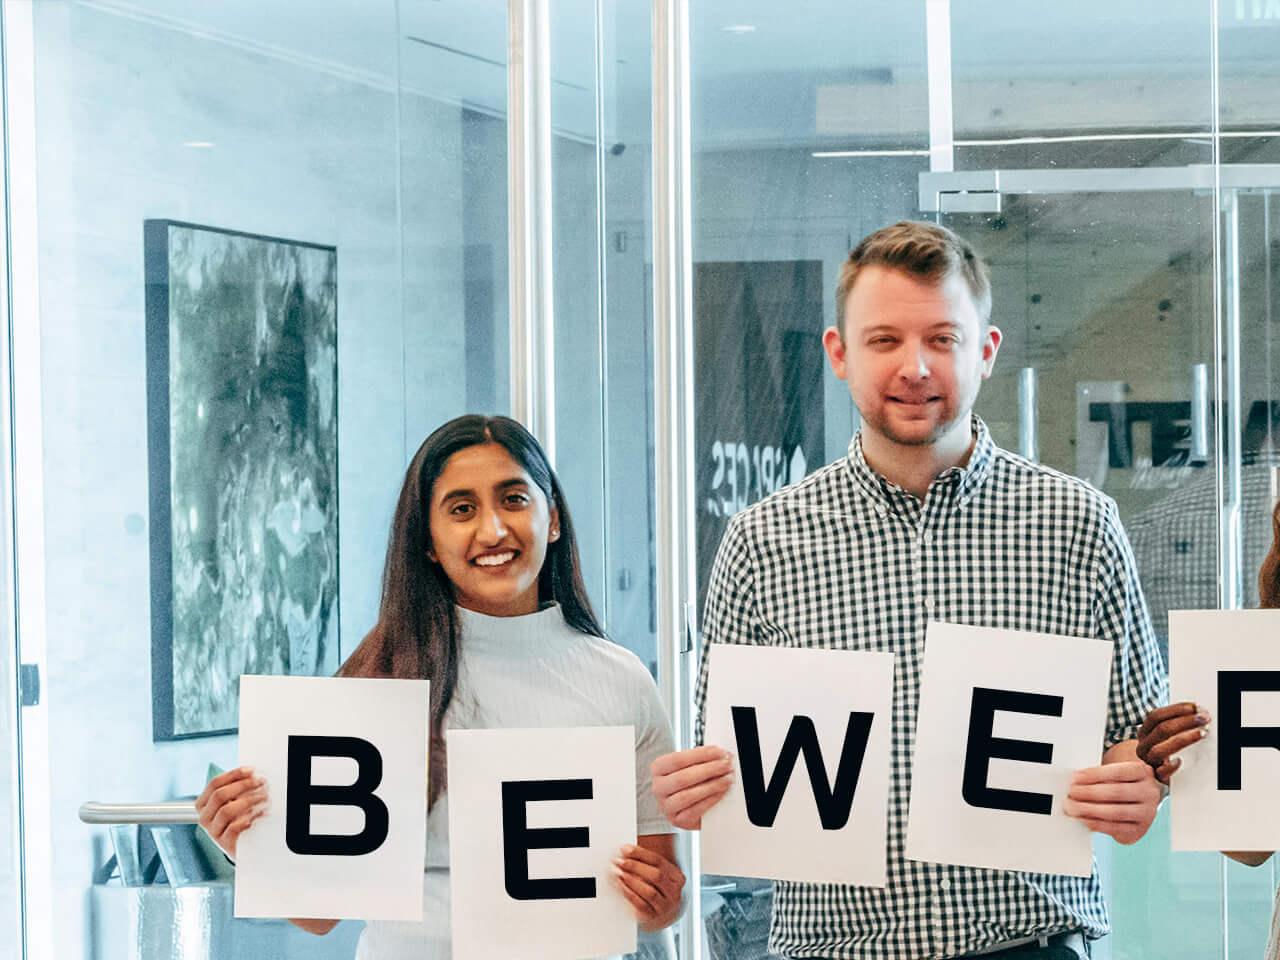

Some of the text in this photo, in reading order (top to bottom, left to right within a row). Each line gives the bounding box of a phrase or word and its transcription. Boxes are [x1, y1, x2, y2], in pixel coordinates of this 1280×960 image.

[285, 735, 389, 857] B
[731, 706, 875, 831] W
[961, 686, 1064, 816] E
[501, 778, 597, 901] E
